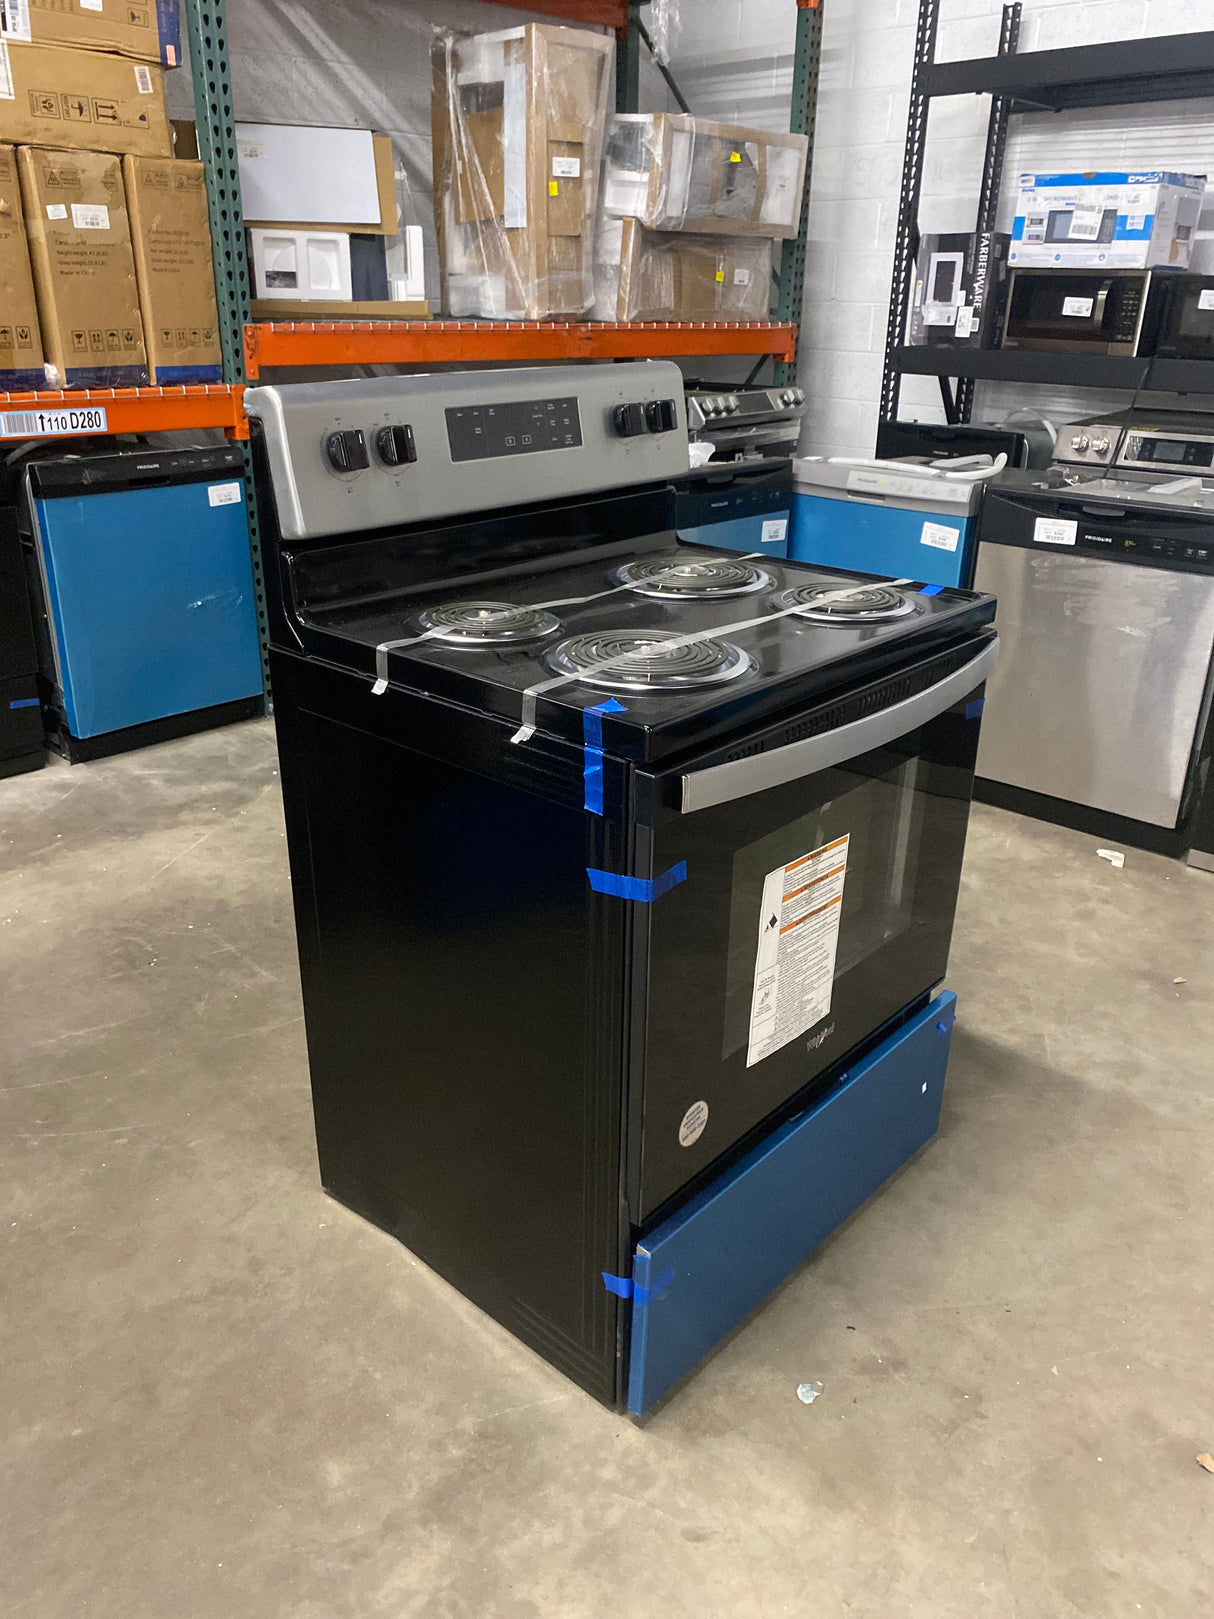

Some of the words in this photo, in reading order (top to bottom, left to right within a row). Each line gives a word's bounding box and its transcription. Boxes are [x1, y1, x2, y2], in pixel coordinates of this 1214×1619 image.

[973, 233, 990, 309] FARBERWARE
[47, 416, 68, 431] 110
[69, 410, 102, 430] D280
[1085, 534, 1112, 543] FRIGIDAIRE
